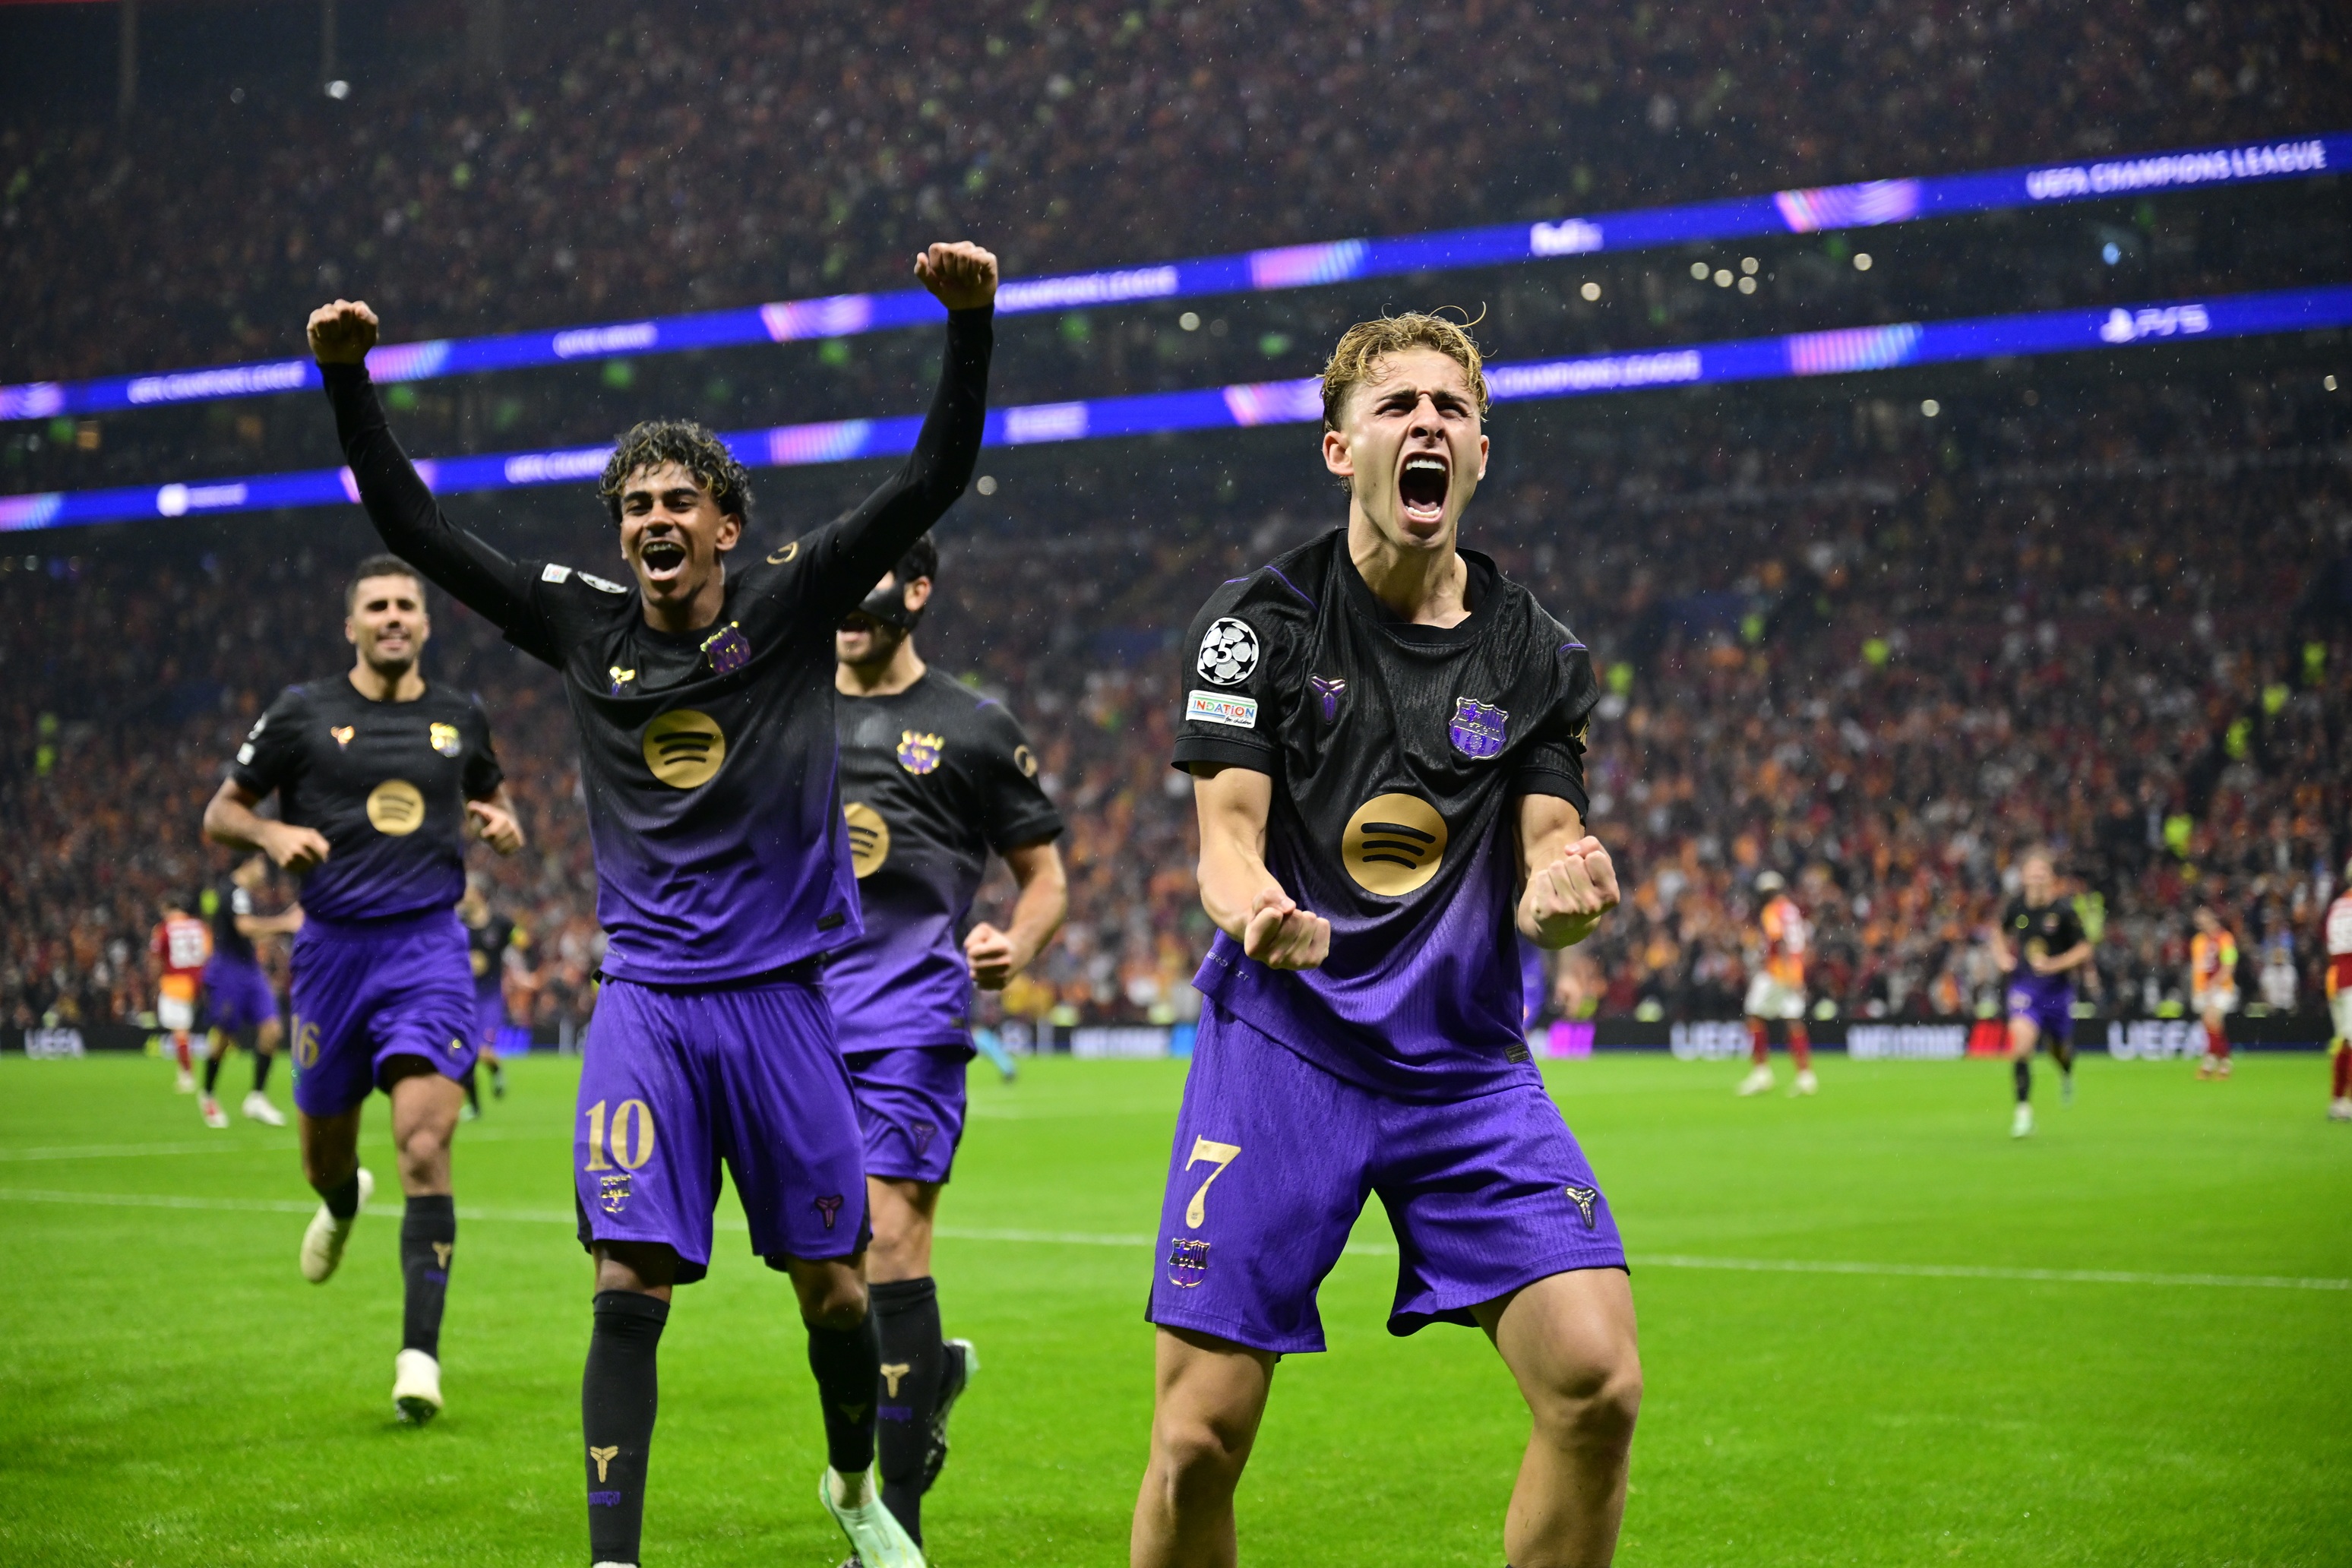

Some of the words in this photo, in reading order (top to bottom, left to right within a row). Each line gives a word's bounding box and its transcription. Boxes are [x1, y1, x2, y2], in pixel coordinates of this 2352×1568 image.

[2026, 166, 2089, 200] UEFA
[2089, 150, 2232, 194] CHAMPIONS
[2231, 139, 2328, 179] LEAGUE
[2135, 304, 2209, 337] PS5
[1215, 637, 1234, 664] 5
[2107, 1019, 2211, 1061] UEFA
[583, 1099, 655, 1171] 10
[1185, 1133, 1242, 1229] 7
